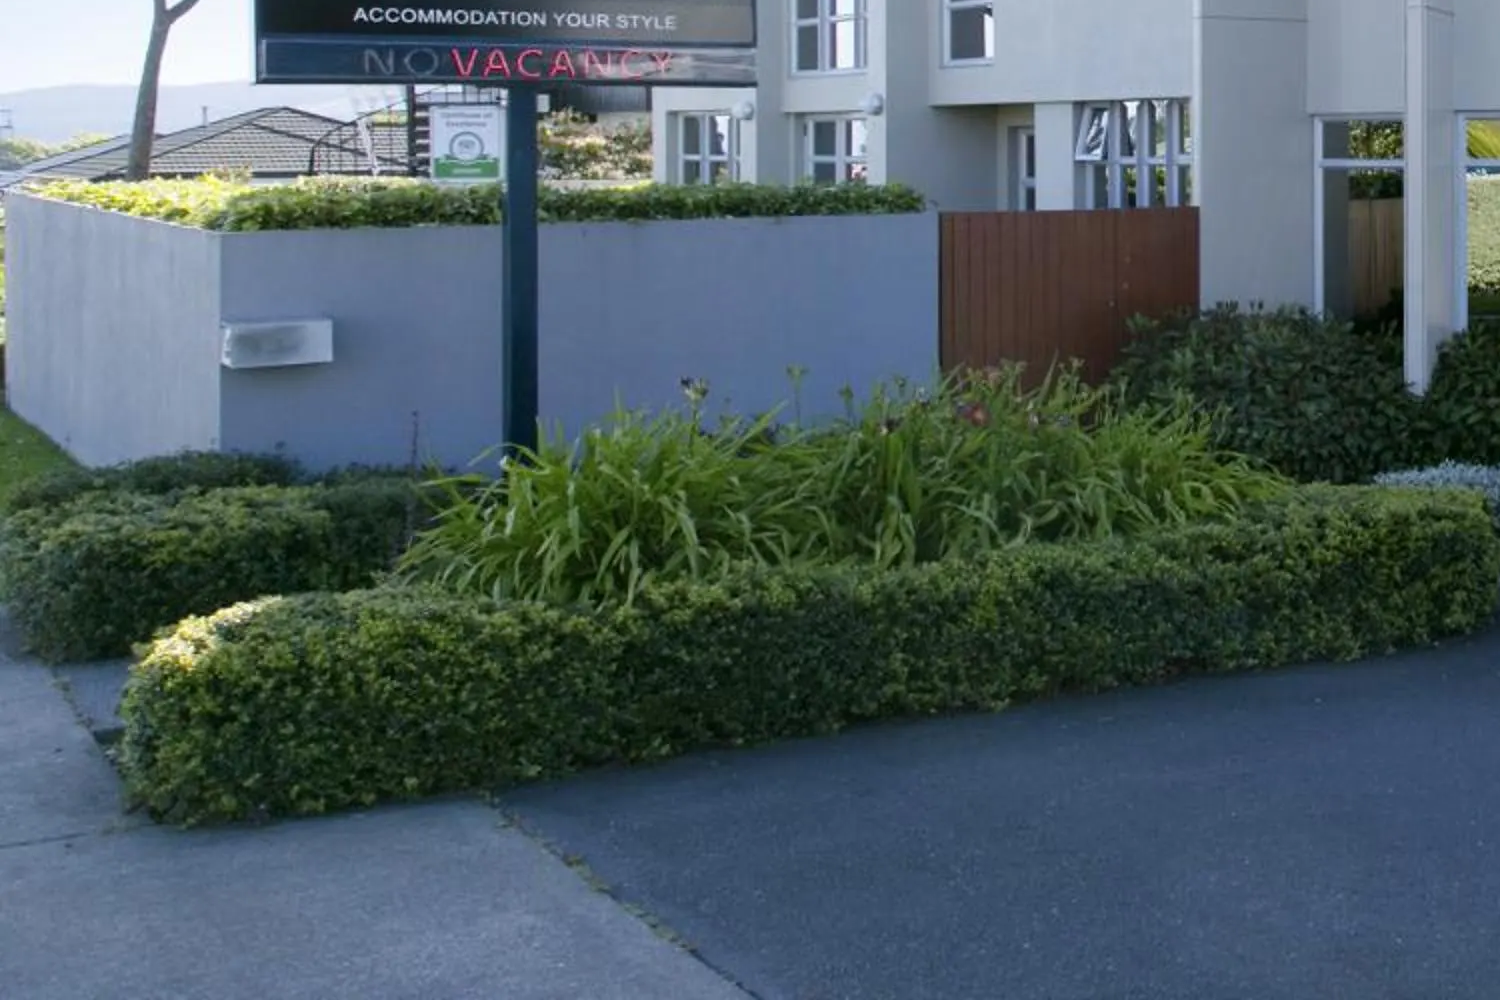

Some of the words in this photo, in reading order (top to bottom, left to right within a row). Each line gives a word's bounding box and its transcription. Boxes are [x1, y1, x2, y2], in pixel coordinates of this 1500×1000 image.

[353, 6, 547, 26] ACCOMMODATION
[553, 12, 609, 29] YOUR
[615, 14, 678, 31] STYLE
[363, 48, 440, 77] NO
[451, 47, 675, 80] VACANCY
